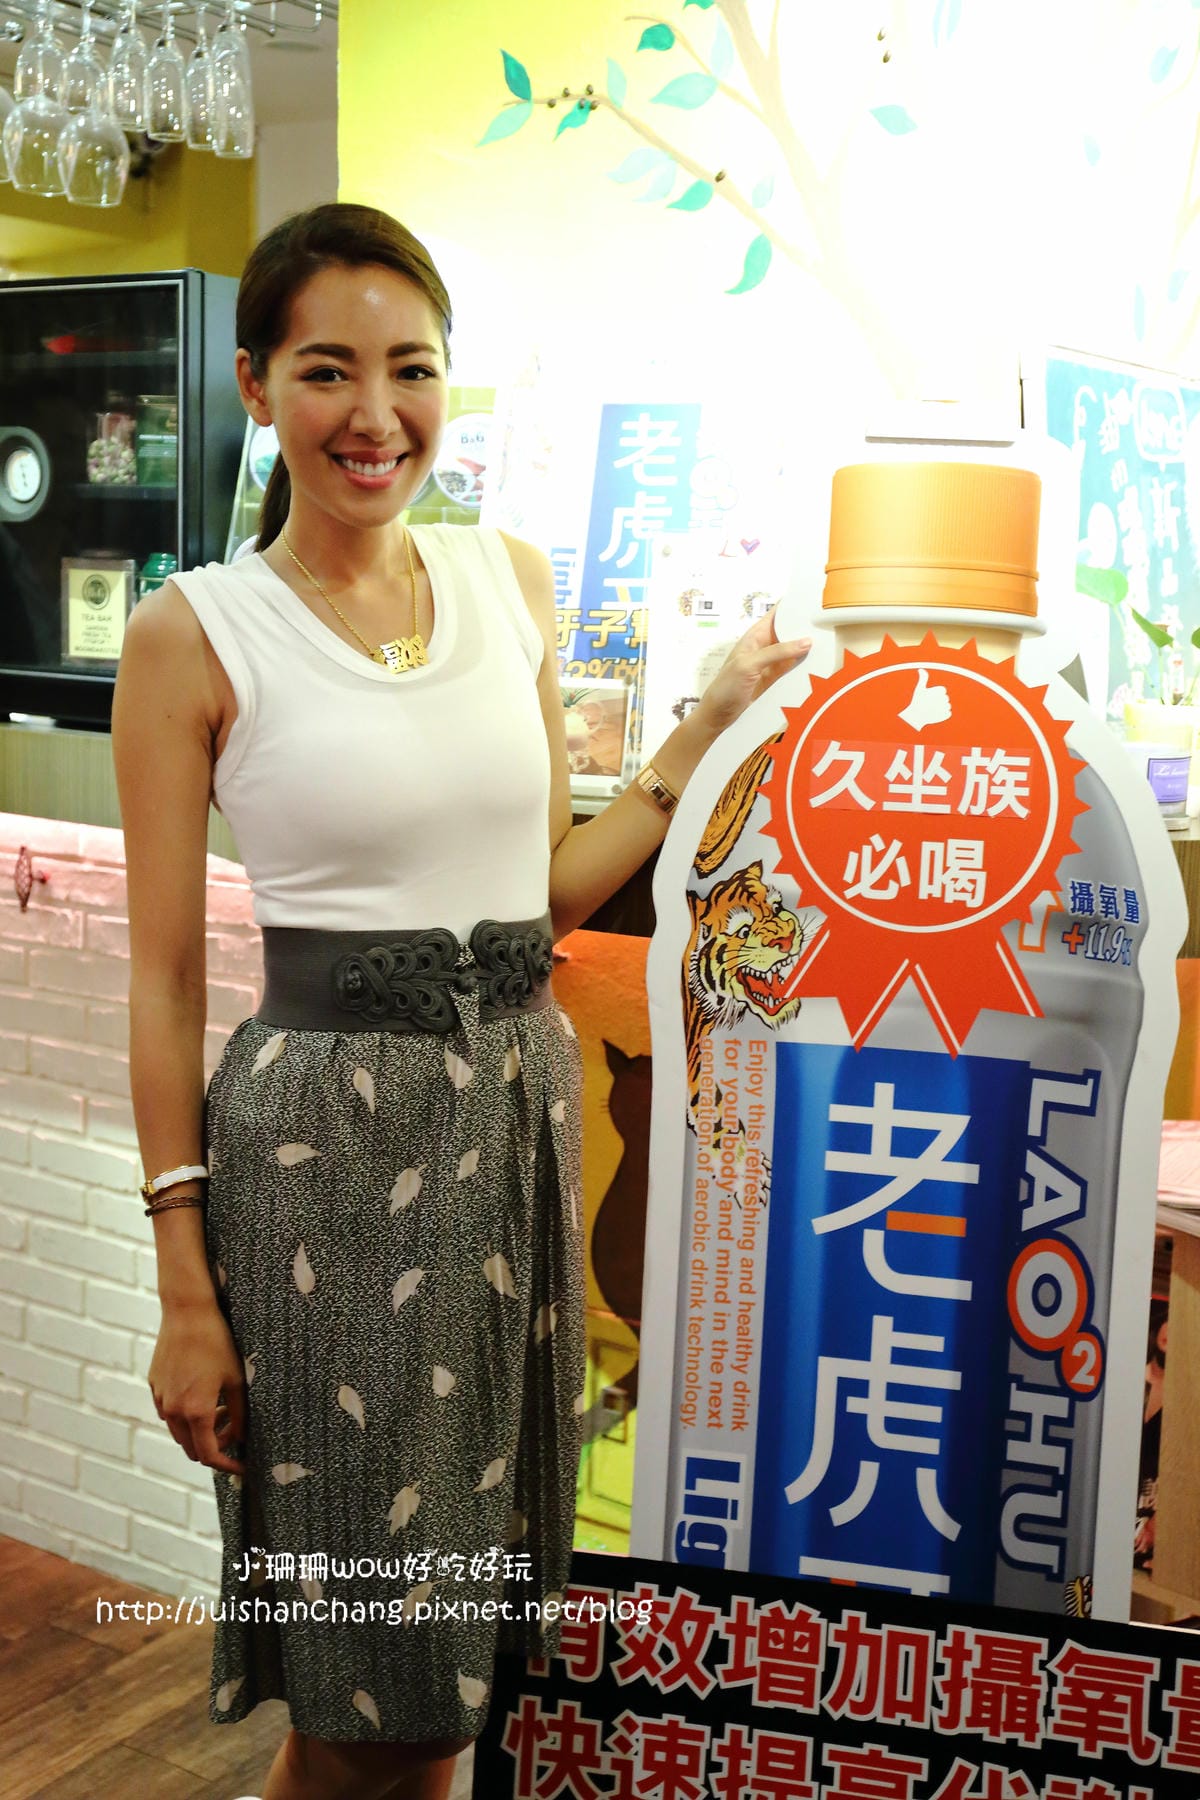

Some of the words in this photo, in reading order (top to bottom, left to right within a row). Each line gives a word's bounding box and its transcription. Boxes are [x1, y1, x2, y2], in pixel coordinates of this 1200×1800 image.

[556, 608, 648, 650] 牙子
[808, 740, 1032, 819] 久坐族
[842, 833, 987, 908] 必喝
[1069, 880, 1139, 924] 攝氧量
[724, 1038, 742, 1070] for
[745, 1040, 767, 1097] Enjoy
[697, 1038, 717, 1147] generation
[720, 1077, 739, 1130] your
[747, 1104, 766, 1142] this
[696, 1153, 714, 1173] of
[716, 1136, 740, 1193] body
[692, 1178, 712, 1253] aerobic
[717, 1200, 734, 1241] and
[737, 1148, 764, 1251] refreshing
[689, 1258, 709, 1309] drink
[713, 1249, 732, 1304] mind
[738, 1257, 757, 1294] and
[712, 1311, 731, 1332] in
[730, 1301, 755, 1375] healthy
[785, 1082, 980, 1597] 老虎
[679, 1316, 705, 1430] technology.
[709, 1339, 729, 1375] the
[706, 1381, 724, 1430] next
[731, 1381, 752, 1431] drink
